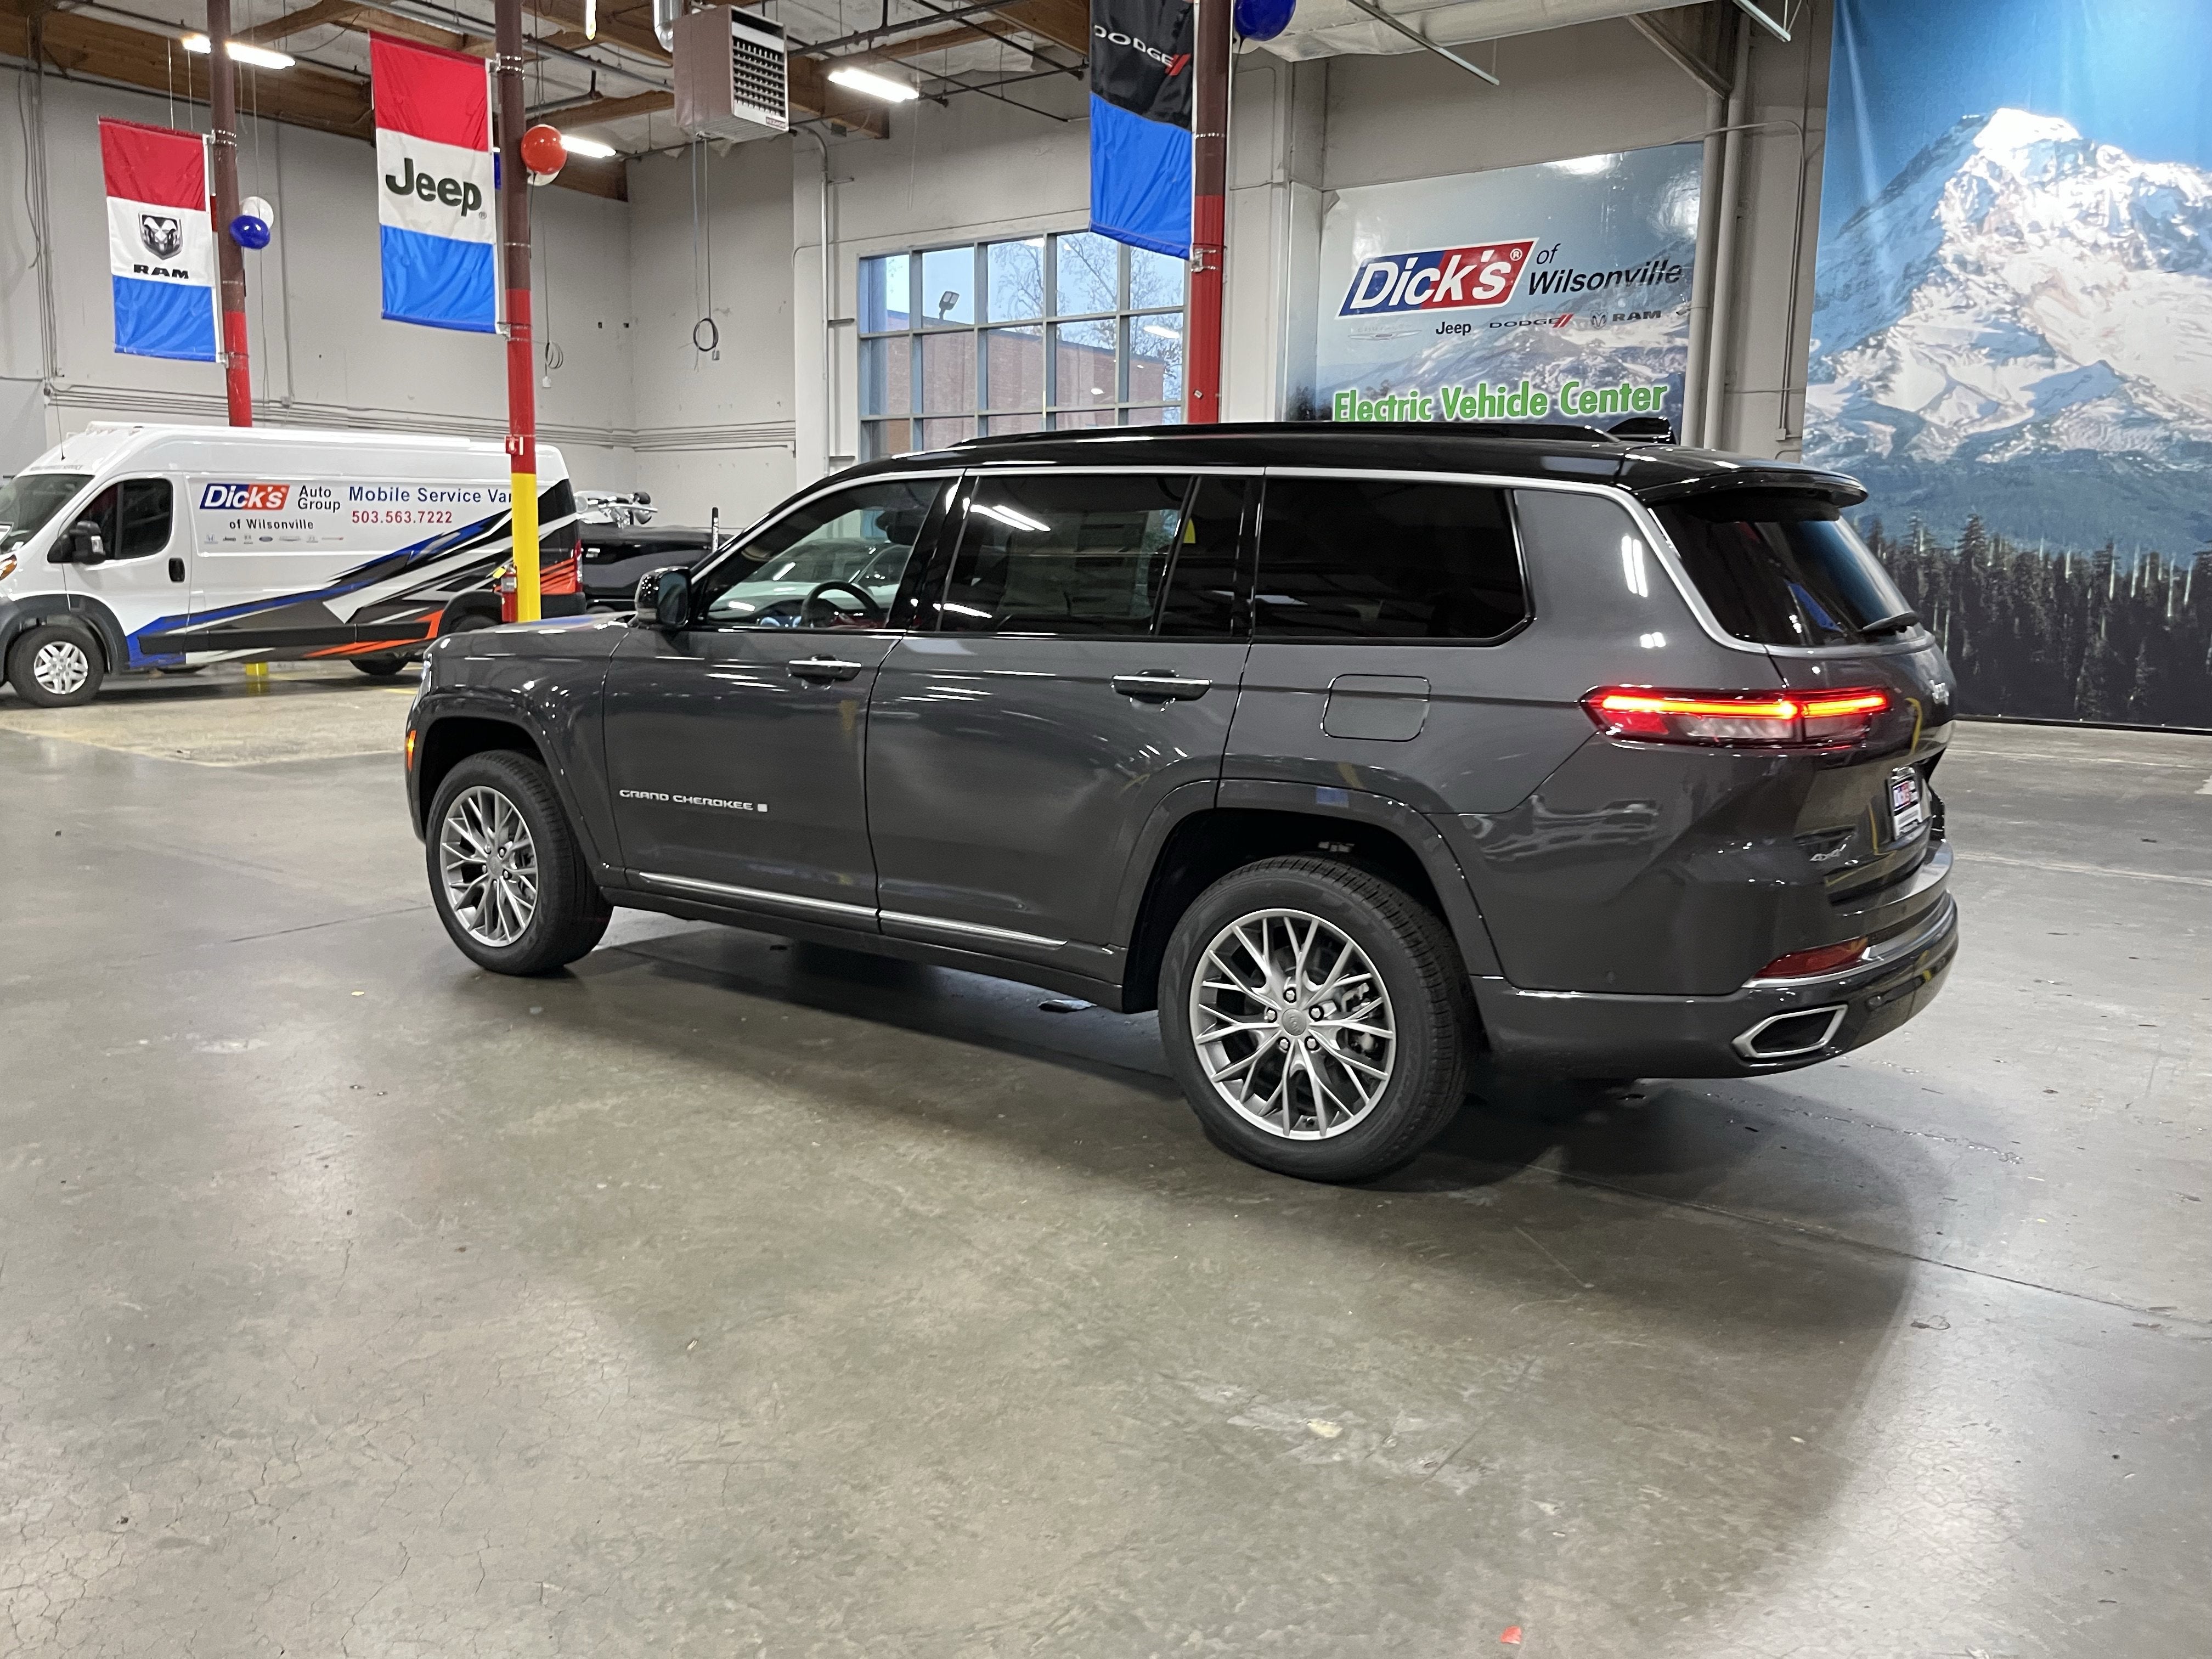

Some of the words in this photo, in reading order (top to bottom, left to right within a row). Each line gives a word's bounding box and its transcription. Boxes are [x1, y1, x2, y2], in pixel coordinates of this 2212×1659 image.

[1094, 25, 1175, 68] DODGE
[385, 157, 482, 217] Jeep
[133, 263, 189, 280] RAM
[1350, 250, 1513, 309] Dick's
[1536, 243, 1561, 265] of
[1528, 258, 1683, 296] Wilsonville
[1489, 317, 1560, 329] DODGE
[1612, 309, 1662, 322] RAM
[1435, 320, 1472, 336] Jeep
[1334, 389, 1432, 422] Electric
[1441, 381, 1548, 419] Vehicle
[1560, 381, 1668, 415] Center
[205, 485, 283, 508] Dick's
[299, 485, 331, 498] Auto
[349, 486, 410, 502] Mobile
[417, 487, 481, 503] Service
[488, 488, 511, 503] Va
[297, 497, 341, 513] Group
[229, 519, 241, 529] of
[246, 519, 314, 529] Wilsonville
[352, 510, 453, 523] 503.563.7222
[619, 789, 669, 801] GRAND
[673, 795, 753, 810] CHEROKEE
